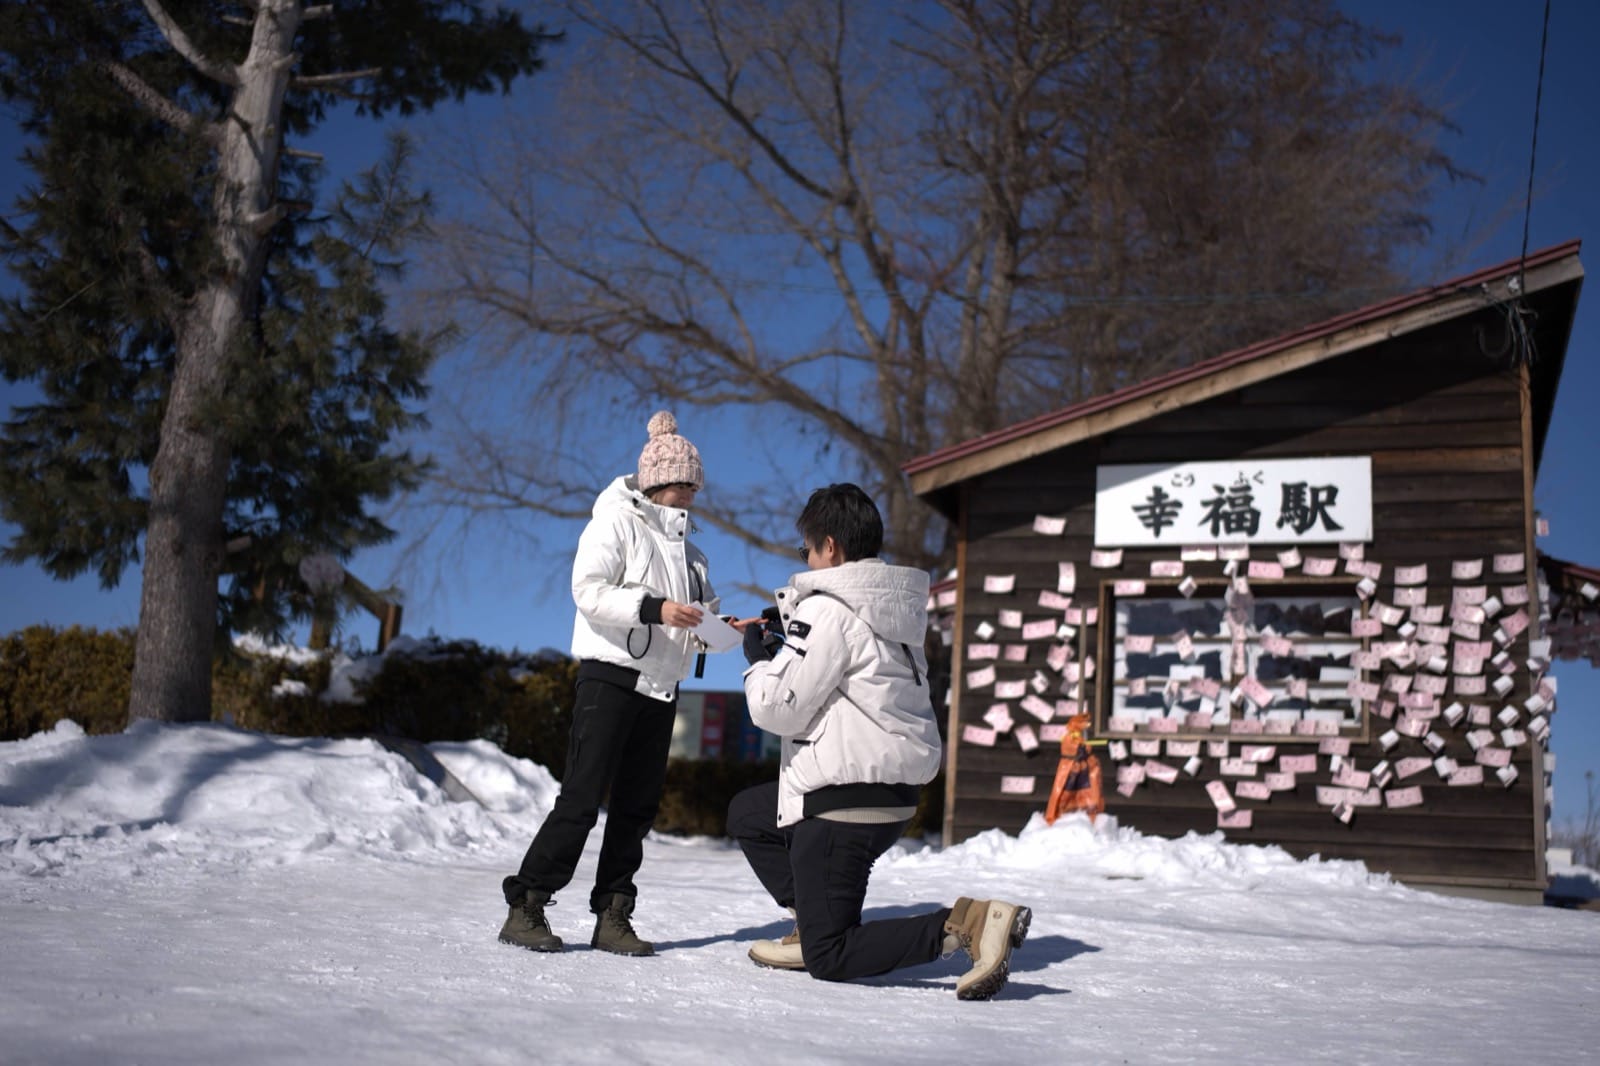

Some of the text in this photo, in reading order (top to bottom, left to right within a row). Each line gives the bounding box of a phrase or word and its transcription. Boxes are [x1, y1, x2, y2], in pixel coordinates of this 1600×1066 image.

[1171, 469, 1265, 487] こう ふく
[1132, 482, 1344, 538] 幸福駅
